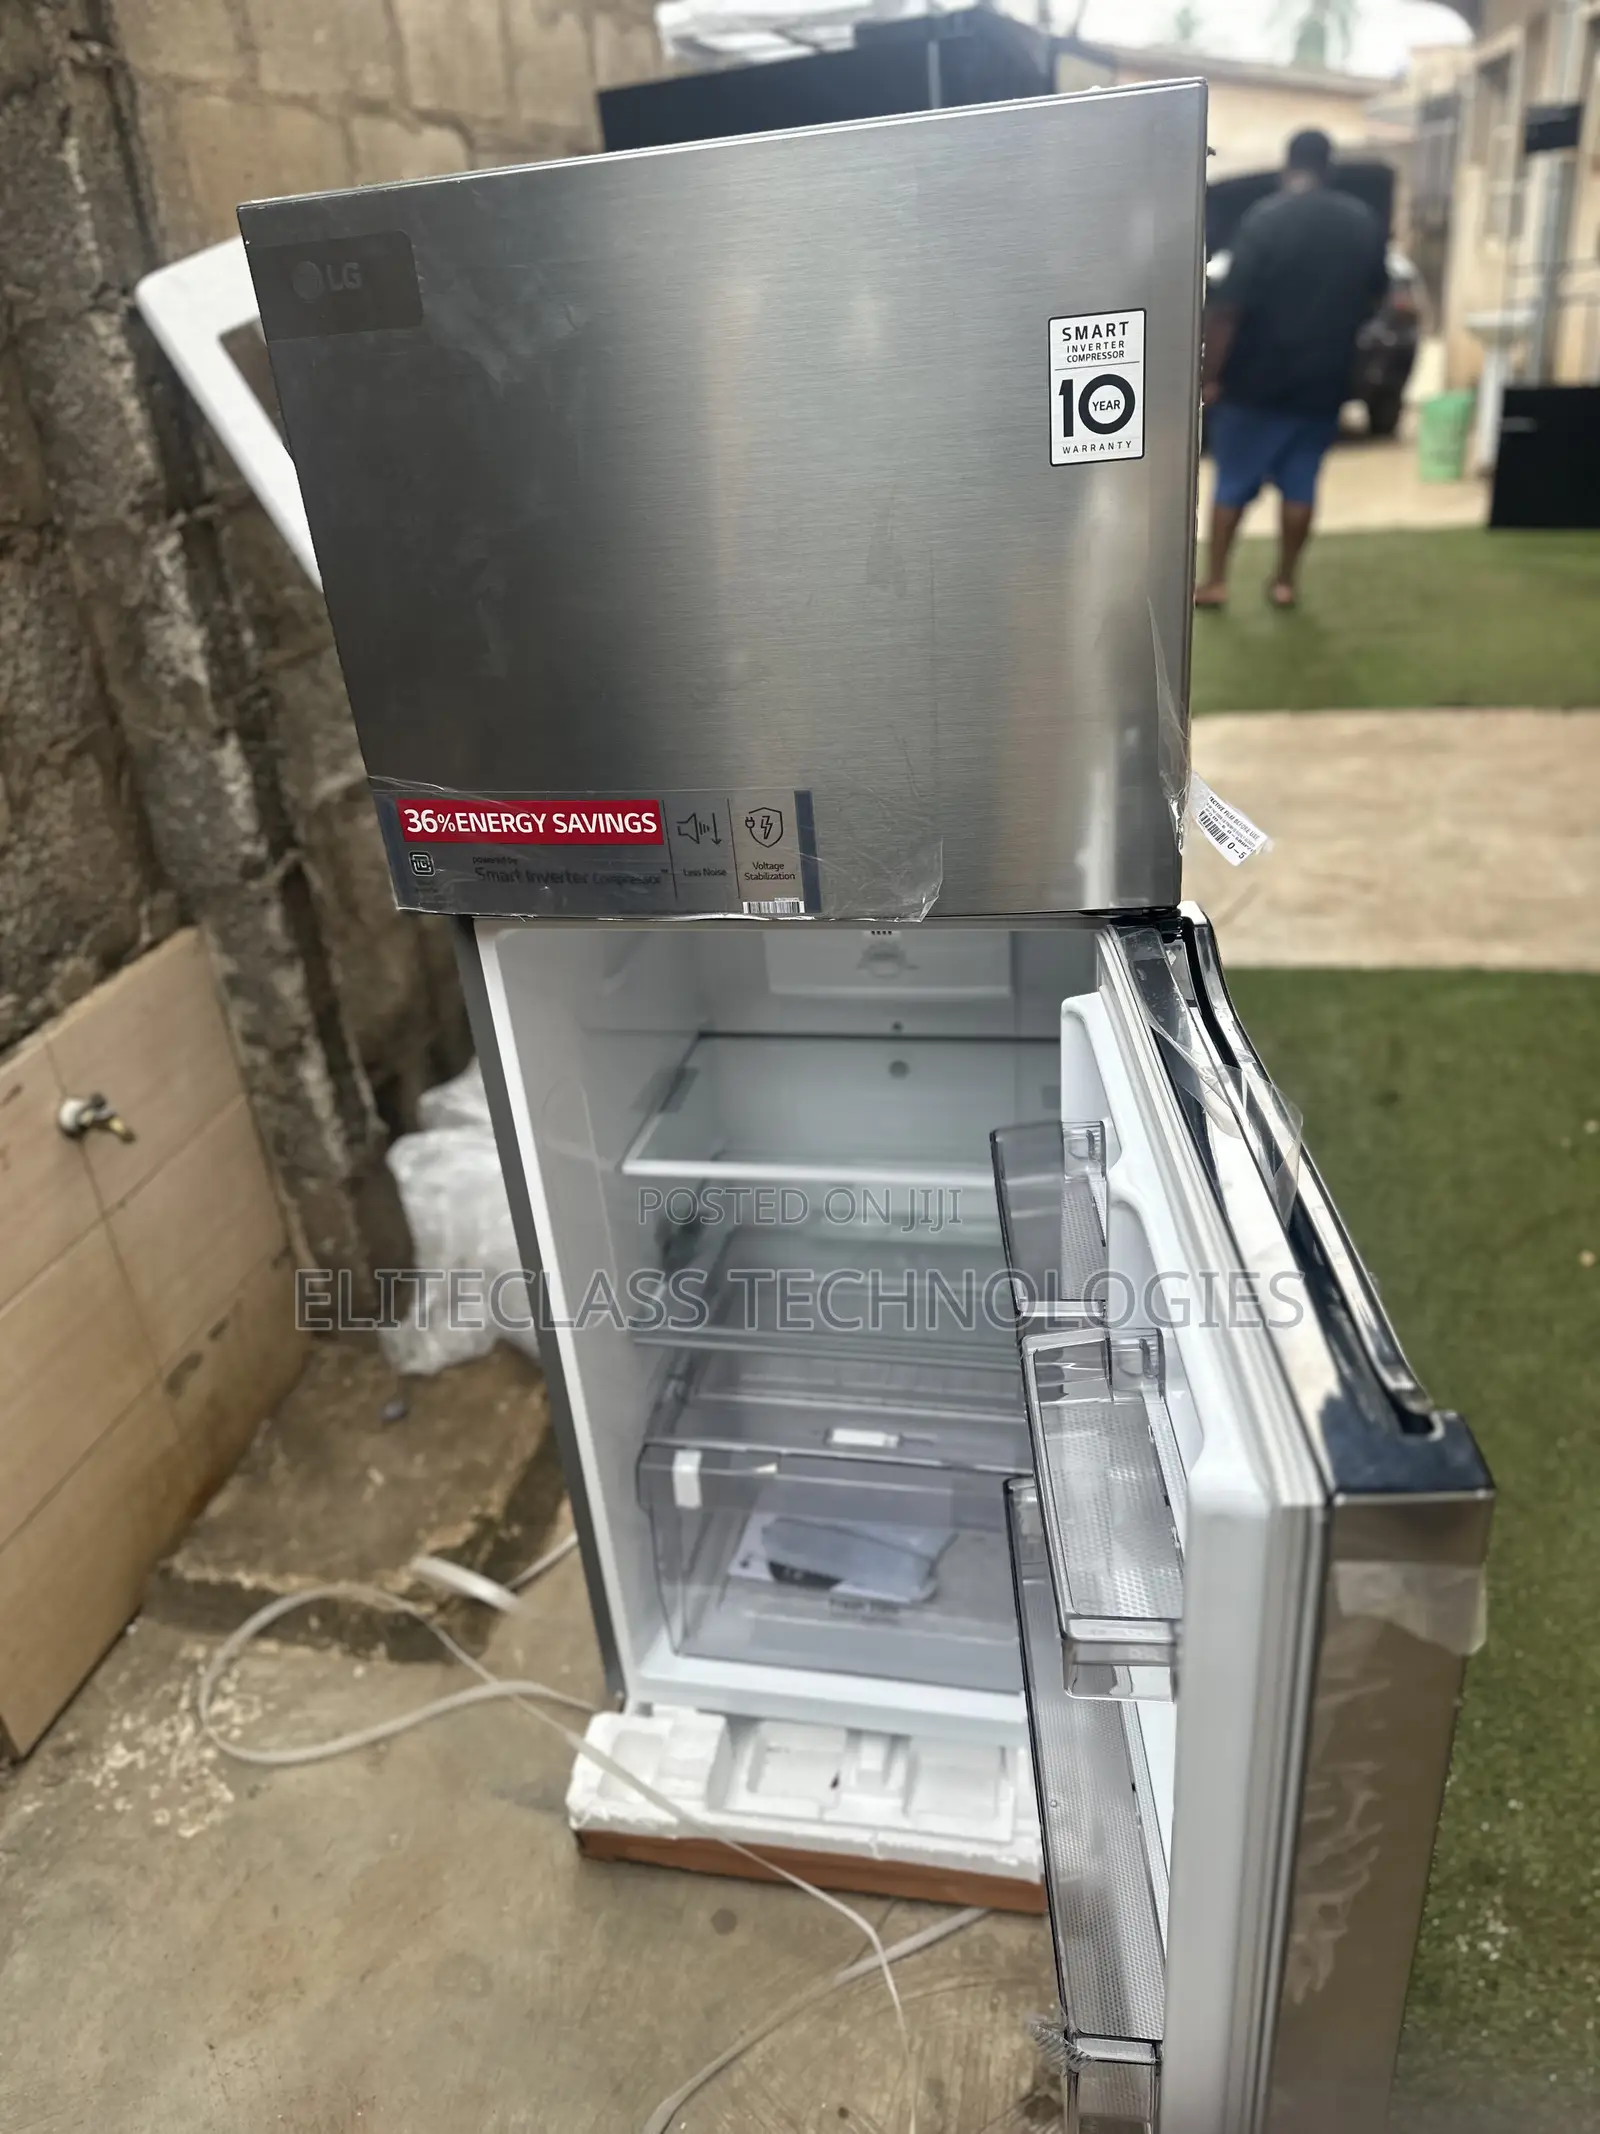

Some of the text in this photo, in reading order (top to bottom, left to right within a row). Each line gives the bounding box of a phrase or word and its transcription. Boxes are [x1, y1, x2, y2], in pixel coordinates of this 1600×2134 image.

[326, 261, 362, 291] LG
[1062, 321, 1129, 342] SMART
[1067, 340, 1125, 353] INVERTER
[1067, 350, 1125, 363] COMPRESSOR
[1058, 373, 1136, 438] 10
[1092, 399, 1121, 412] YEAR
[1062, 440, 1132, 455] WARRANTY
[552, 812, 658, 834] SAVINGS
[704, 867, 728, 877] Noise
[752, 861, 785, 872] Voltage
[475, 867, 520, 883] Smart
[525, 868, 588, 884] Inverter
[744, 871, 796, 881] Stabilization
